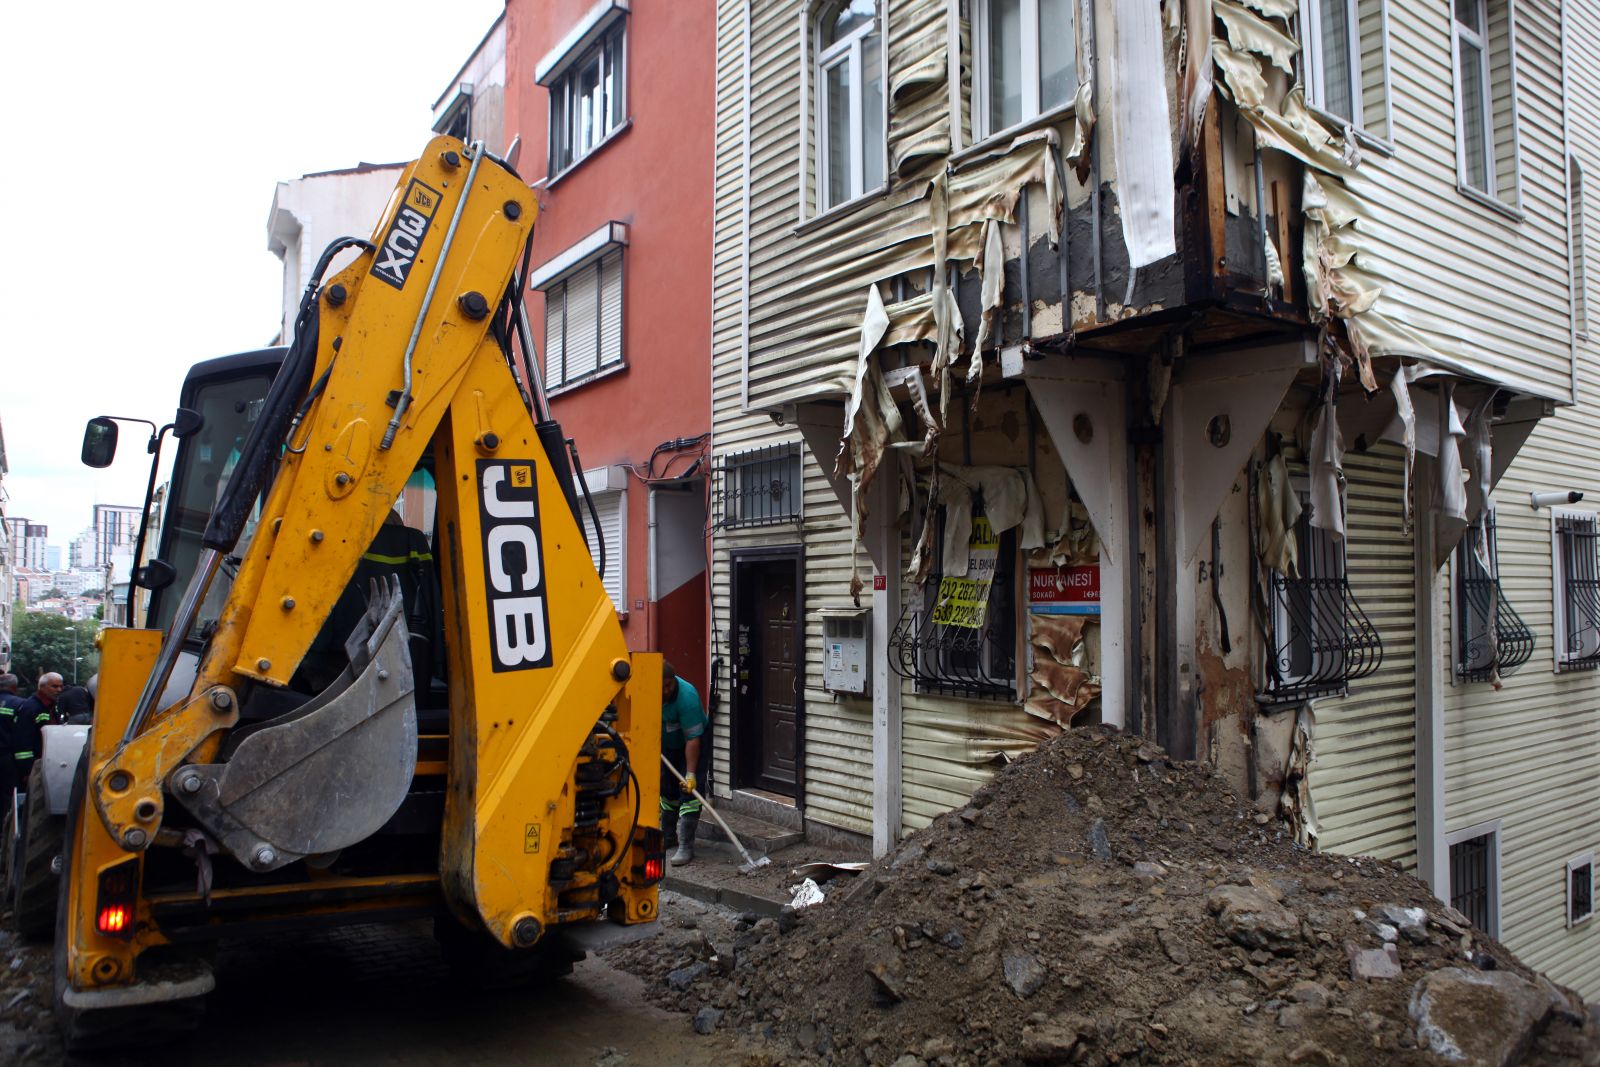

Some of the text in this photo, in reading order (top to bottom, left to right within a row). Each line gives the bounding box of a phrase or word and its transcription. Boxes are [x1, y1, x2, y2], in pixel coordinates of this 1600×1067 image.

[415, 190, 431, 208] JCB
[376, 209, 427, 281] 3CX
[483, 465, 547, 666] JCB
[1032, 590, 1055, 599] SOKAĞI
